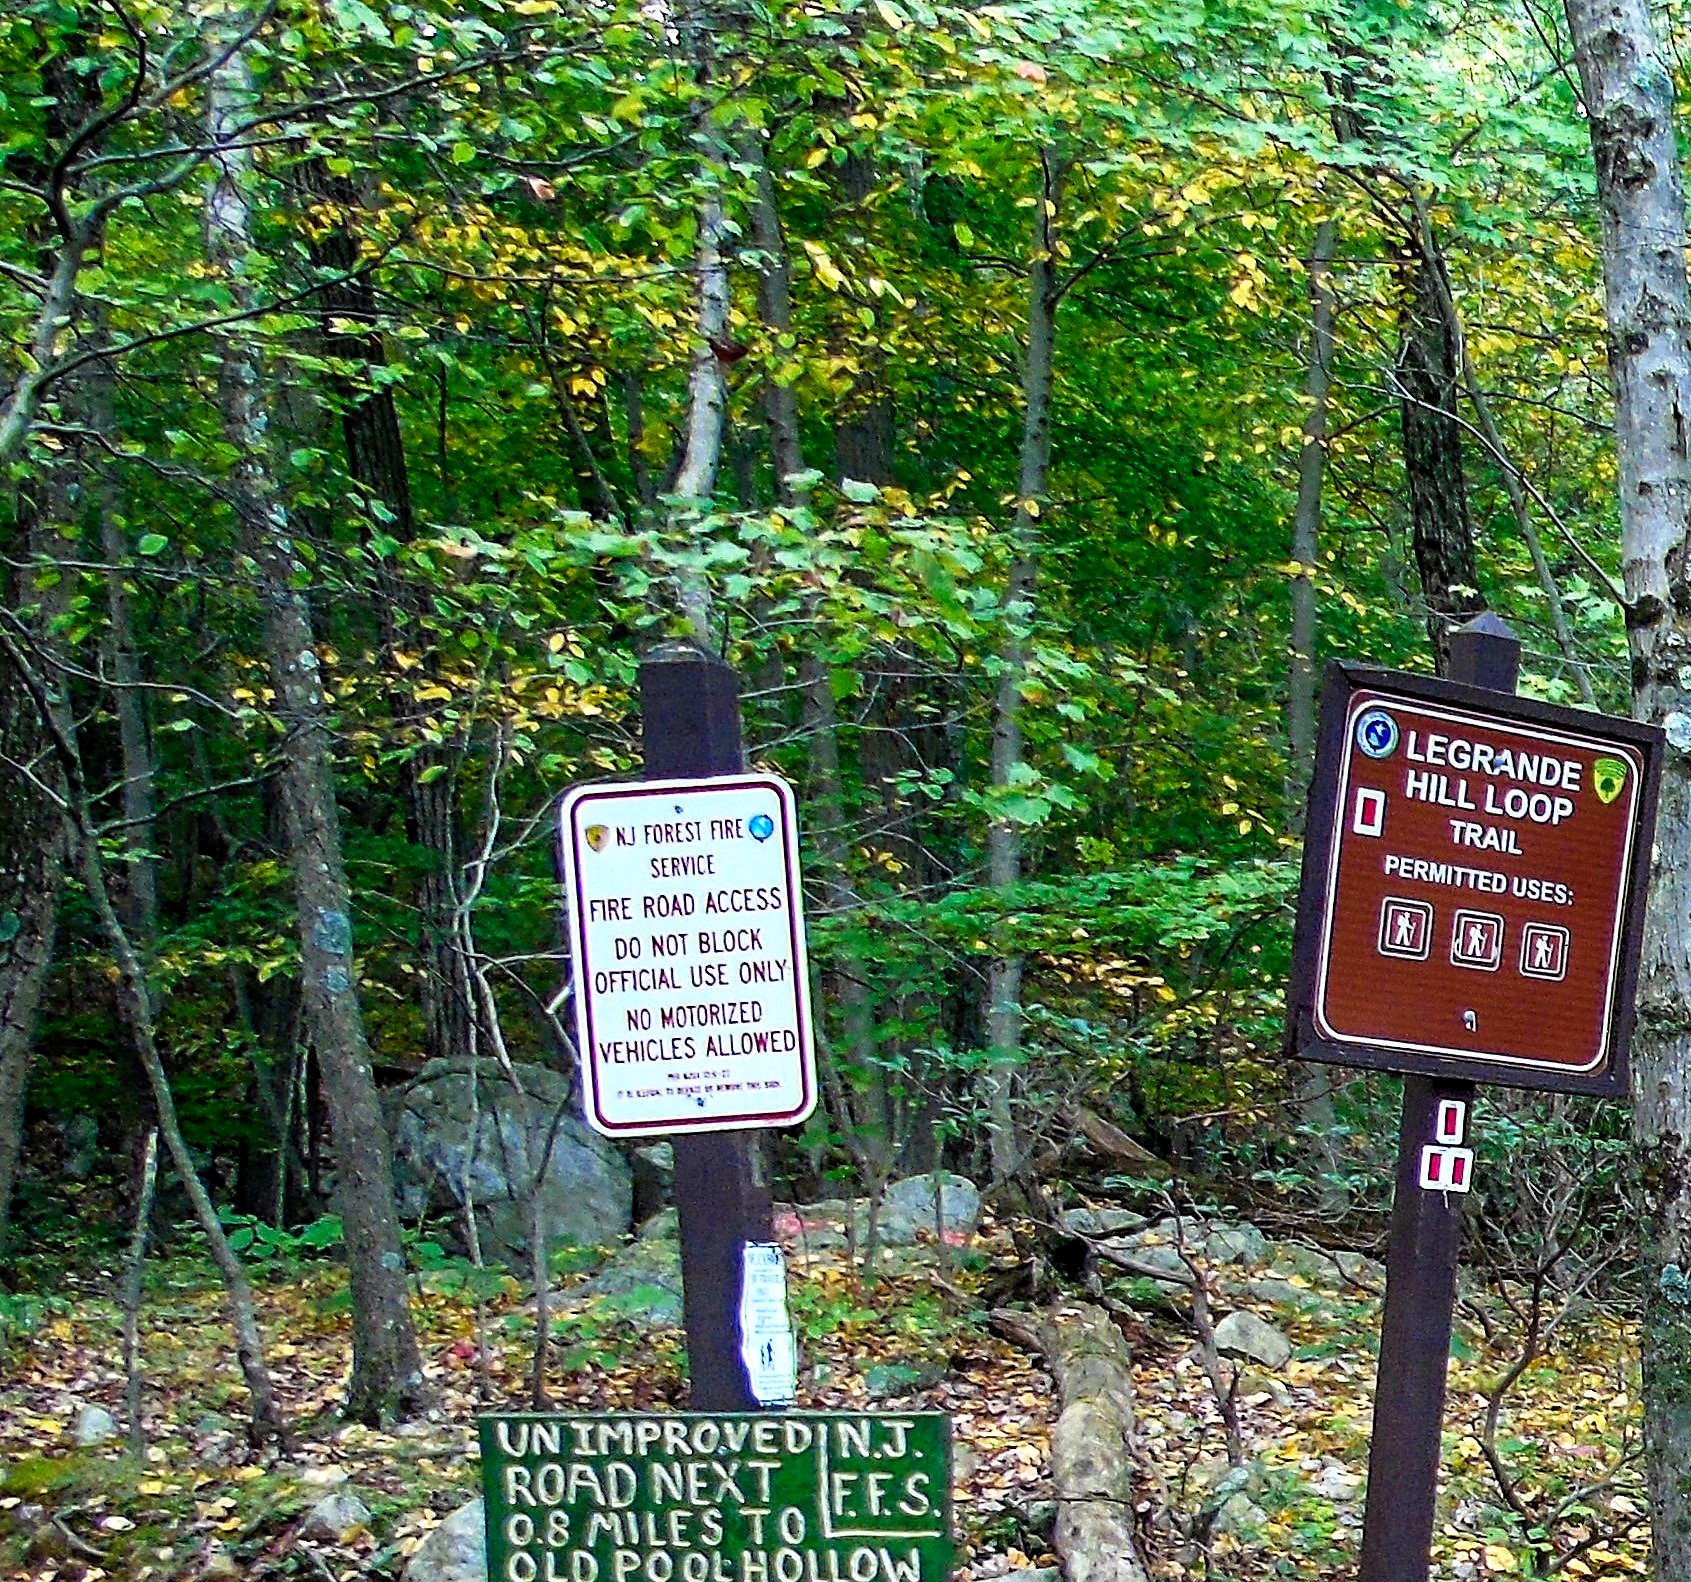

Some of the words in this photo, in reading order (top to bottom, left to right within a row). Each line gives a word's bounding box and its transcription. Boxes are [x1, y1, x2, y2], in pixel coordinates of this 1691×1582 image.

[1406, 730, 1583, 791] LEGRANDE
[1406, 770, 1476, 810] HILL
[1484, 786, 1574, 825] LOOP
[616, 827, 636, 847] NJ
[645, 820, 702, 844] FOREST
[711, 818, 744, 840] FIRE
[1449, 819, 1523, 855] TRAIL
[650, 854, 716, 879] SERVICE
[1384, 856, 1507, 894] PERMITTED
[1512, 878, 1574, 906] USES:
[590, 897, 632, 922] FIRE
[644, 893, 695, 918] ROAD
[705, 887, 783, 914] ACCESS
[615, 937, 641, 960] DO
[652, 933, 688, 957] NOT
[699, 928, 763, 954] BLOCK
[595, 967, 682, 994] OFFICIAL
[691, 964, 729, 987] USE
[740, 960, 787, 984] ONLY
[627, 1008, 651, 1031] NO
[661, 1001, 763, 1028] MOTORIZED
[599, 1037, 696, 1064] VEHICLES
[706, 1030, 795, 1057] ALLOWED
[838, 1420, 924, 1458] N.J.
[505, 1463, 637, 1508] ROAD
[653, 1461, 782, 1505] NEXT
[830, 1472, 943, 1518] F.F.S.
[507, 1513, 570, 1548] 0.8
[587, 1509, 723, 1548] MILES
[739, 1506, 806, 1546] TO
